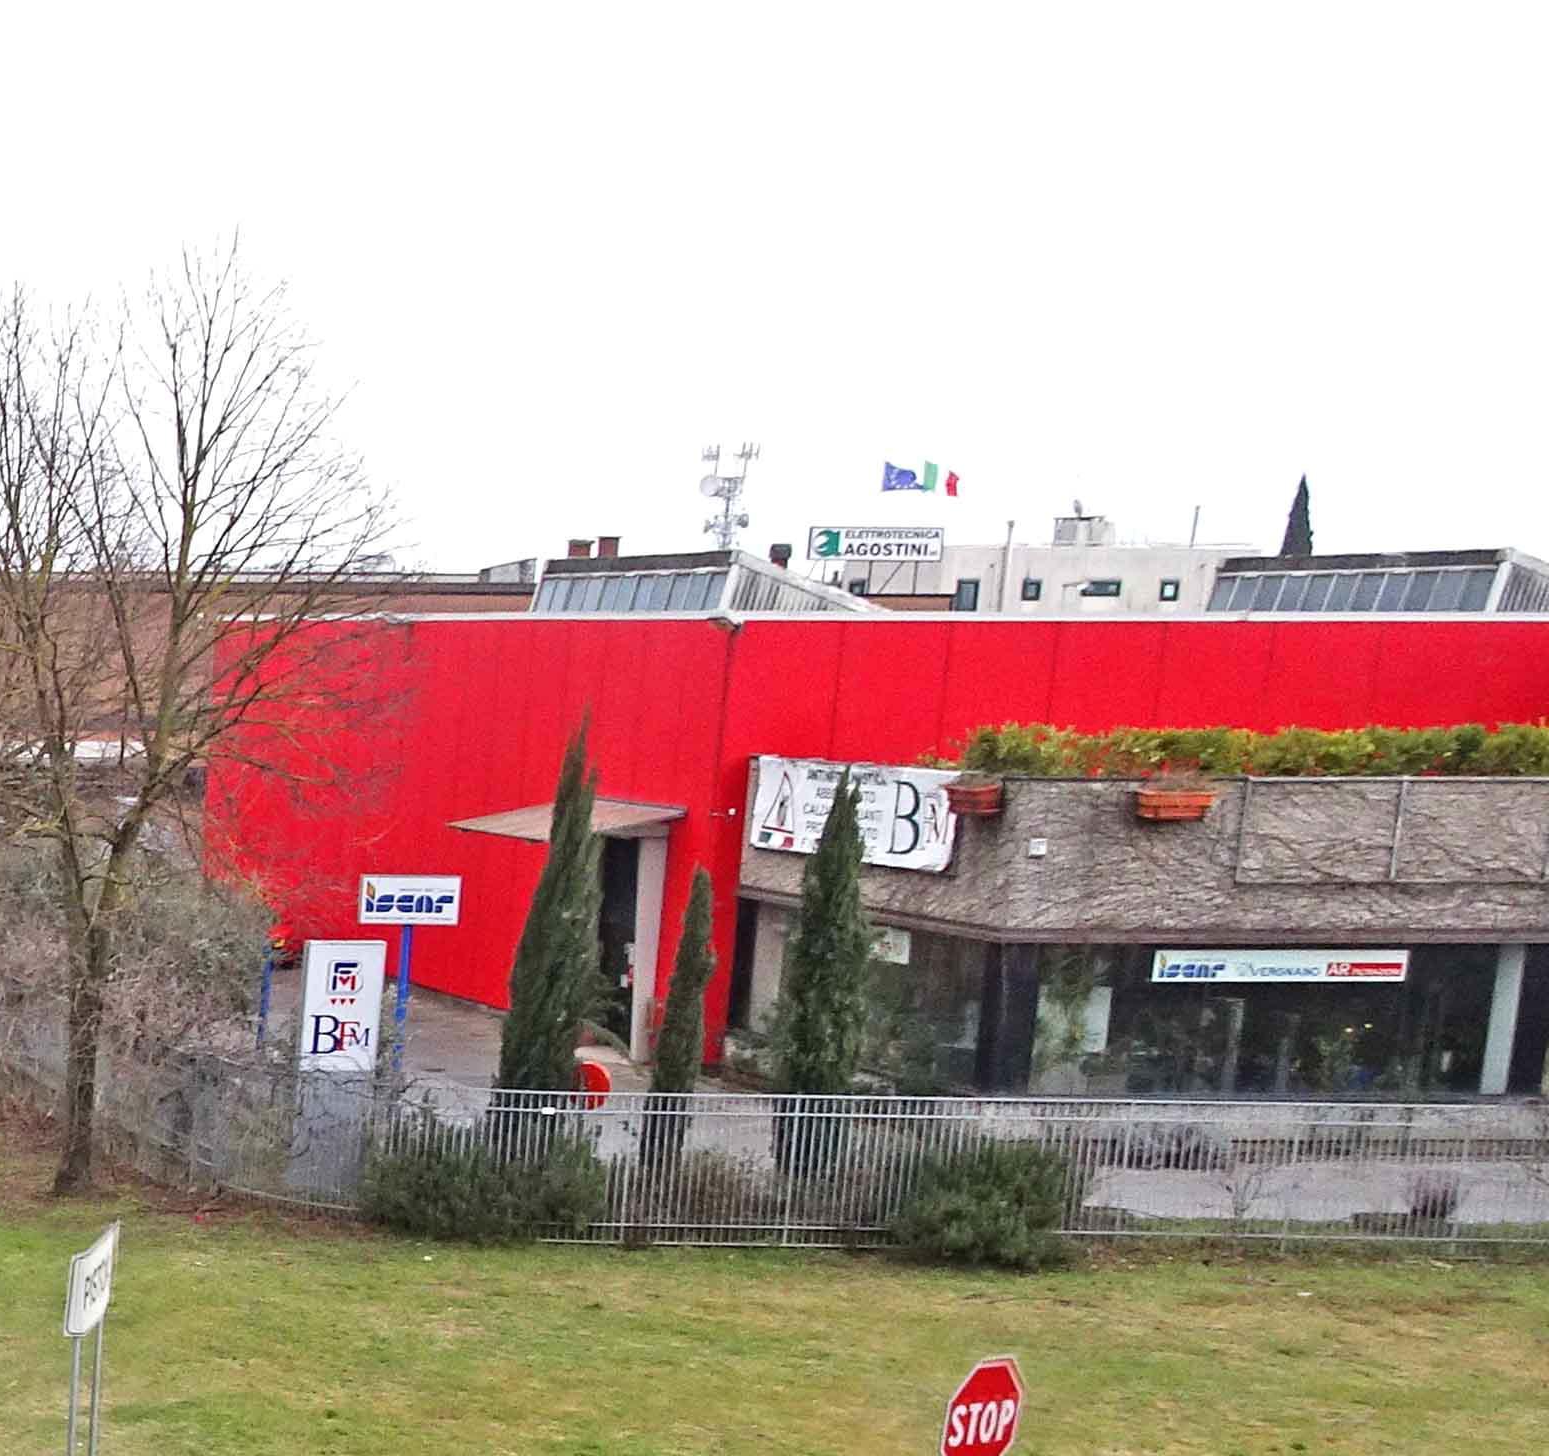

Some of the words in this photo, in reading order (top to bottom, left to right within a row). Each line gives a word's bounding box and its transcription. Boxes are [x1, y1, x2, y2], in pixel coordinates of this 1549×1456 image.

[844, 530, 940, 539] ELETTROTECNICA
[844, 543, 928, 556] AGOSTINI
[948, 1398, 1016, 1448] STOP
